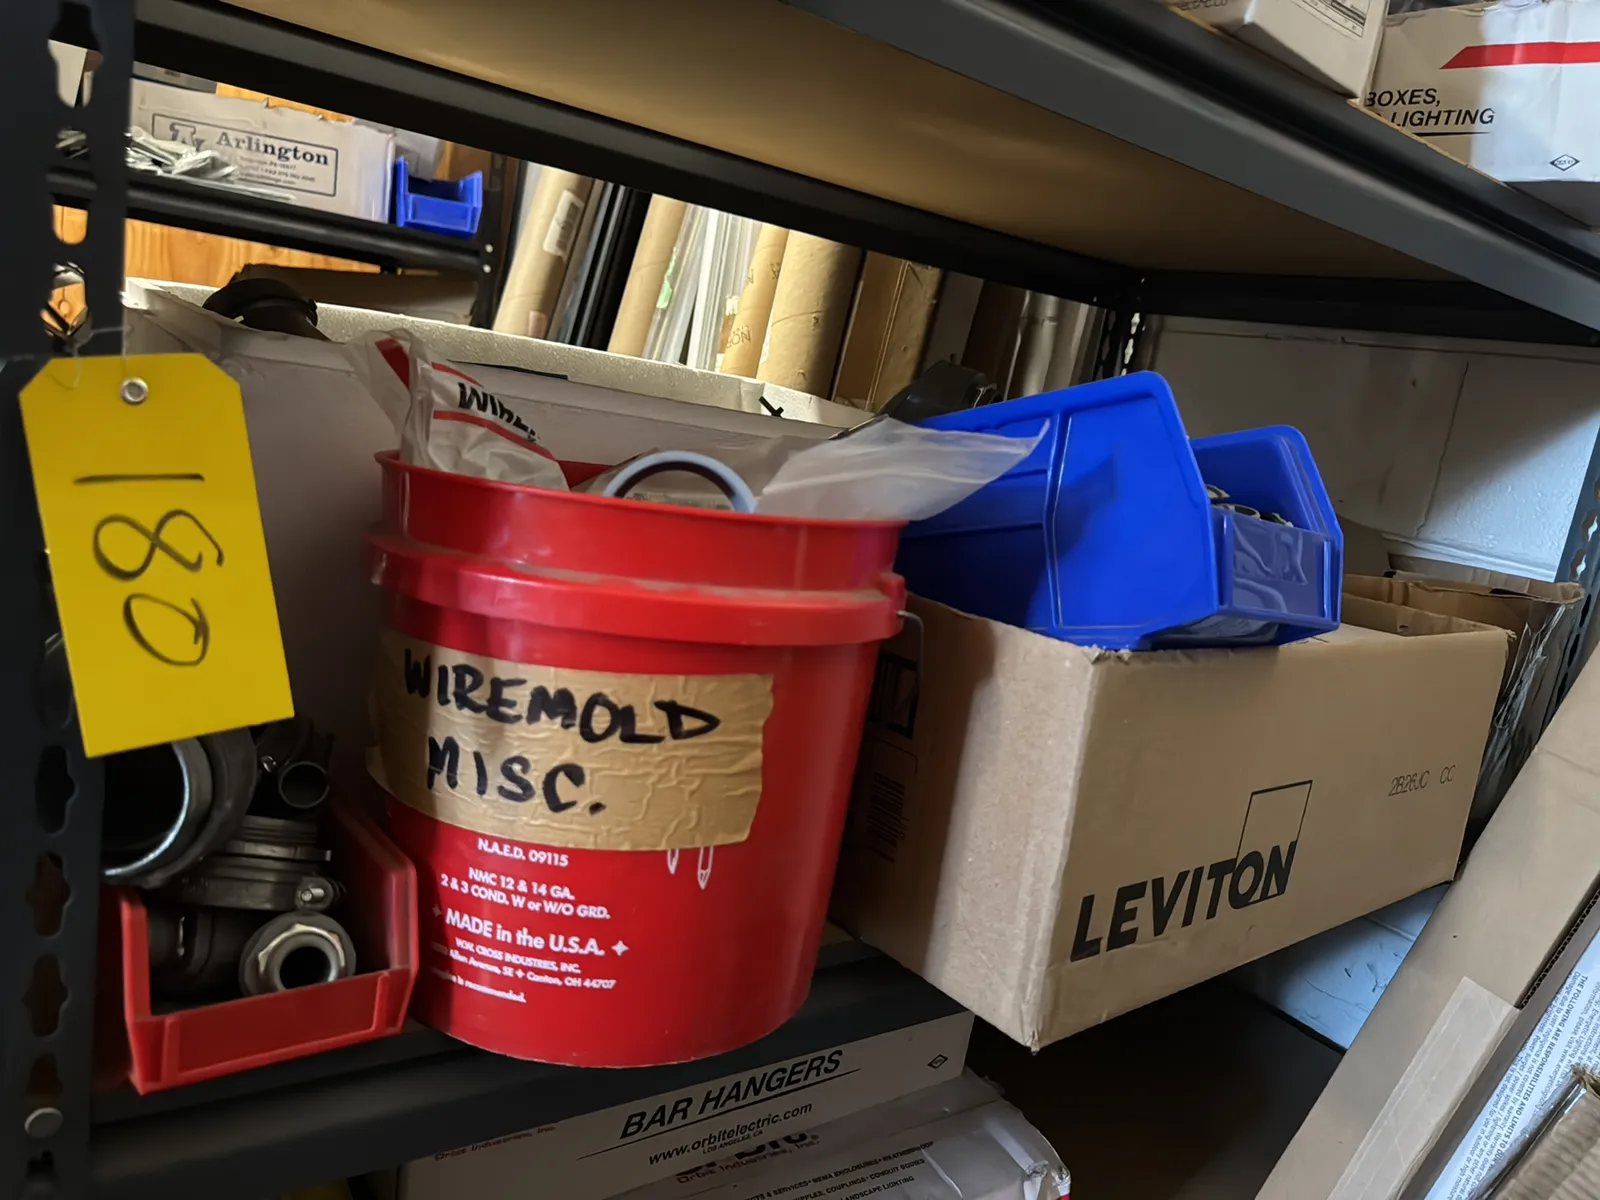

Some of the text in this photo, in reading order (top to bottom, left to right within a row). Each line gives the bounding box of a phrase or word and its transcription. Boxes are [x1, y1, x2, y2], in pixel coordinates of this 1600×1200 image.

[1391, 108, 1496, 127] LIGHTING
[216, 131, 329, 166] Arlington
[73, 473, 224, 667] 180
[404, 648, 721, 744] WIREMOLD
[427, 736, 606, 816] MISC.
[478, 838, 569, 867] N.A.E.D. 09115
[440, 873, 611, 919] 2 & 3 COND. W or W/O GRD.
[468, 867, 575, 900] NMC 12 & 14 GA.
[1070, 840, 1297, 962] LEVITON
[446, 908, 605, 956] MADE in the U.S.A.
[475, 944, 504, 961] CROSS
[564, 977, 581, 988] OH
[1578, 975, 1588, 989] THE
[1558, 989, 1581, 1028] FOLLOWING
[1552, 1028, 1562, 1042] ARE
[1523, 1041, 1555, 1101] RESPONSIBILITIES
[619, 1050, 843, 1140] BAR HANGERS
[1516, 1101, 1526, 1116] AND
[649, 1103, 813, 1165] www.orbitelectric.com
[1500, 1139, 1508, 1149] TO
[1504, 1116, 1519, 1139] LIMITS
